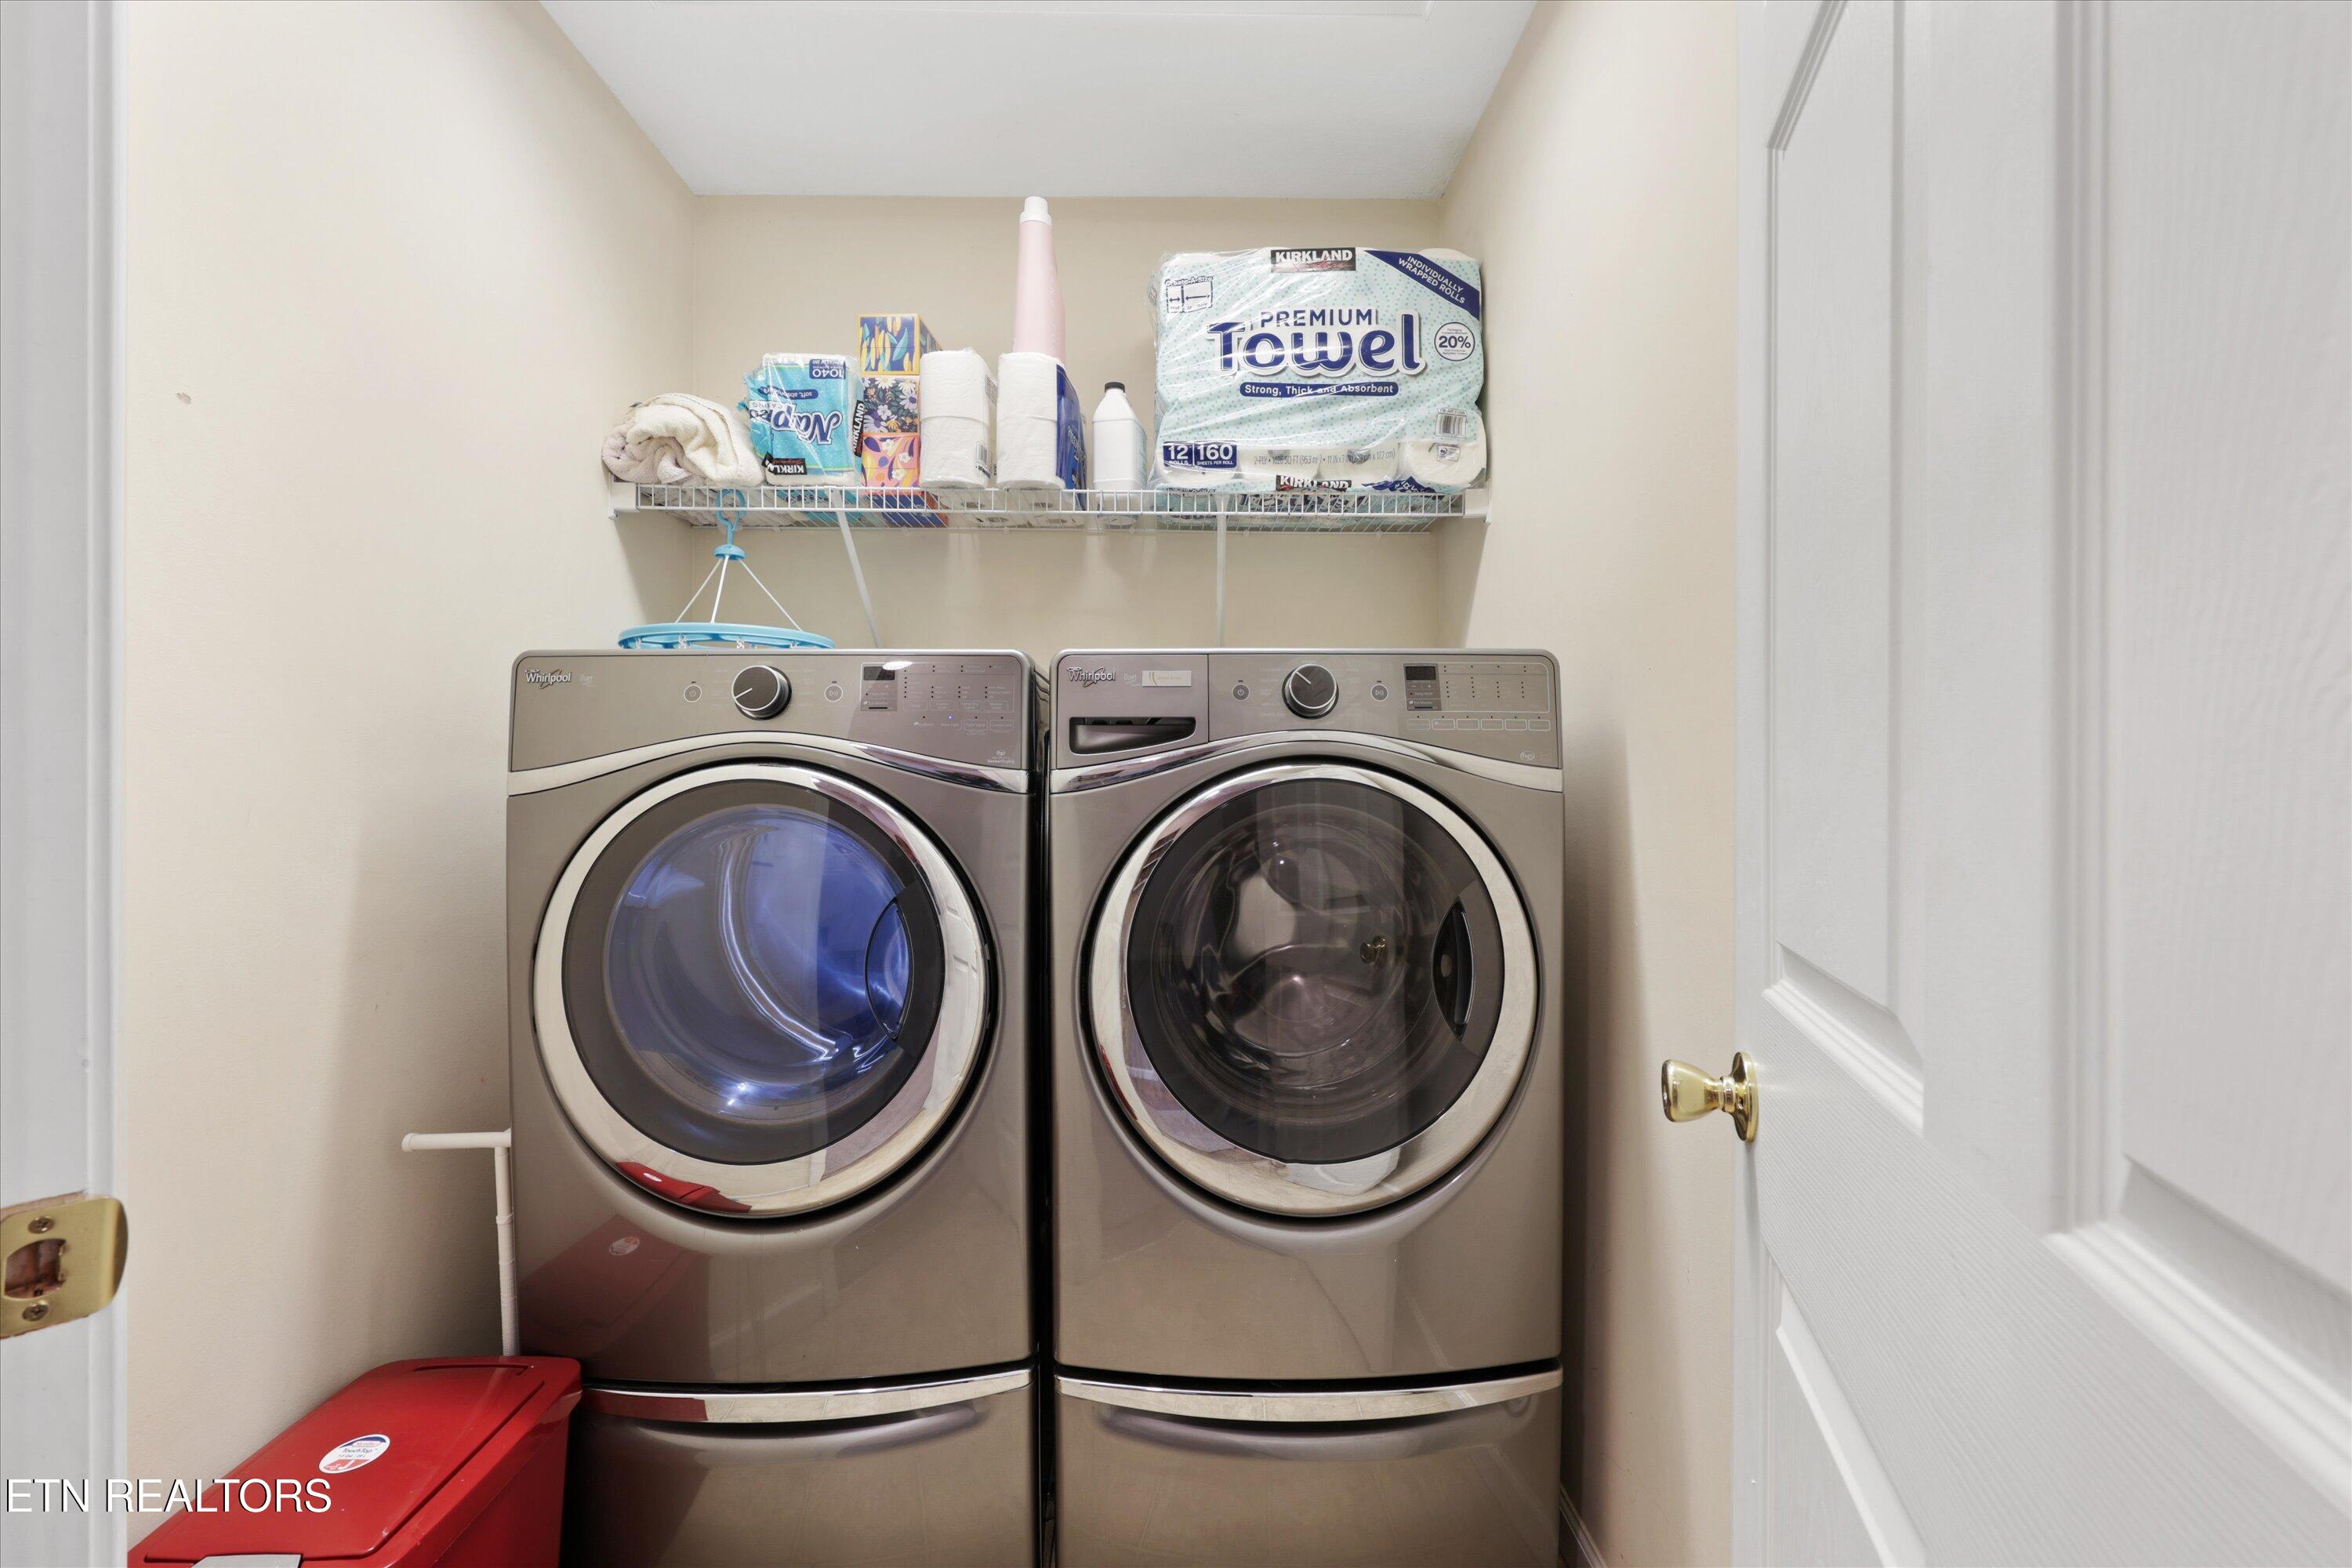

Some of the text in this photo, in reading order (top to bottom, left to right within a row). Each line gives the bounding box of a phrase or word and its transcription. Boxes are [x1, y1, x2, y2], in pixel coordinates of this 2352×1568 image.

[1275, 249, 1353, 263] KIRKLAND
[1399, 257, 1465, 303] WRAPPED ROLLS
[1407, 256, 1464, 292] INDIVIDUALLY
[1261, 308, 1373, 328] PREMIUM
[1207, 314, 1421, 372] Towel
[1439, 335, 1472, 349] 20%
[812, 368, 844, 378] 1040
[1244, 384, 1282, 396] Strong,
[1286, 386, 1313, 394] Thick
[1341, 383, 1393, 393] Absorbent
[1168, 444, 1233, 460] 12 160
[524, 671, 572, 686] Whirlpool
[1067, 669, 1116, 685] Whirlpool
